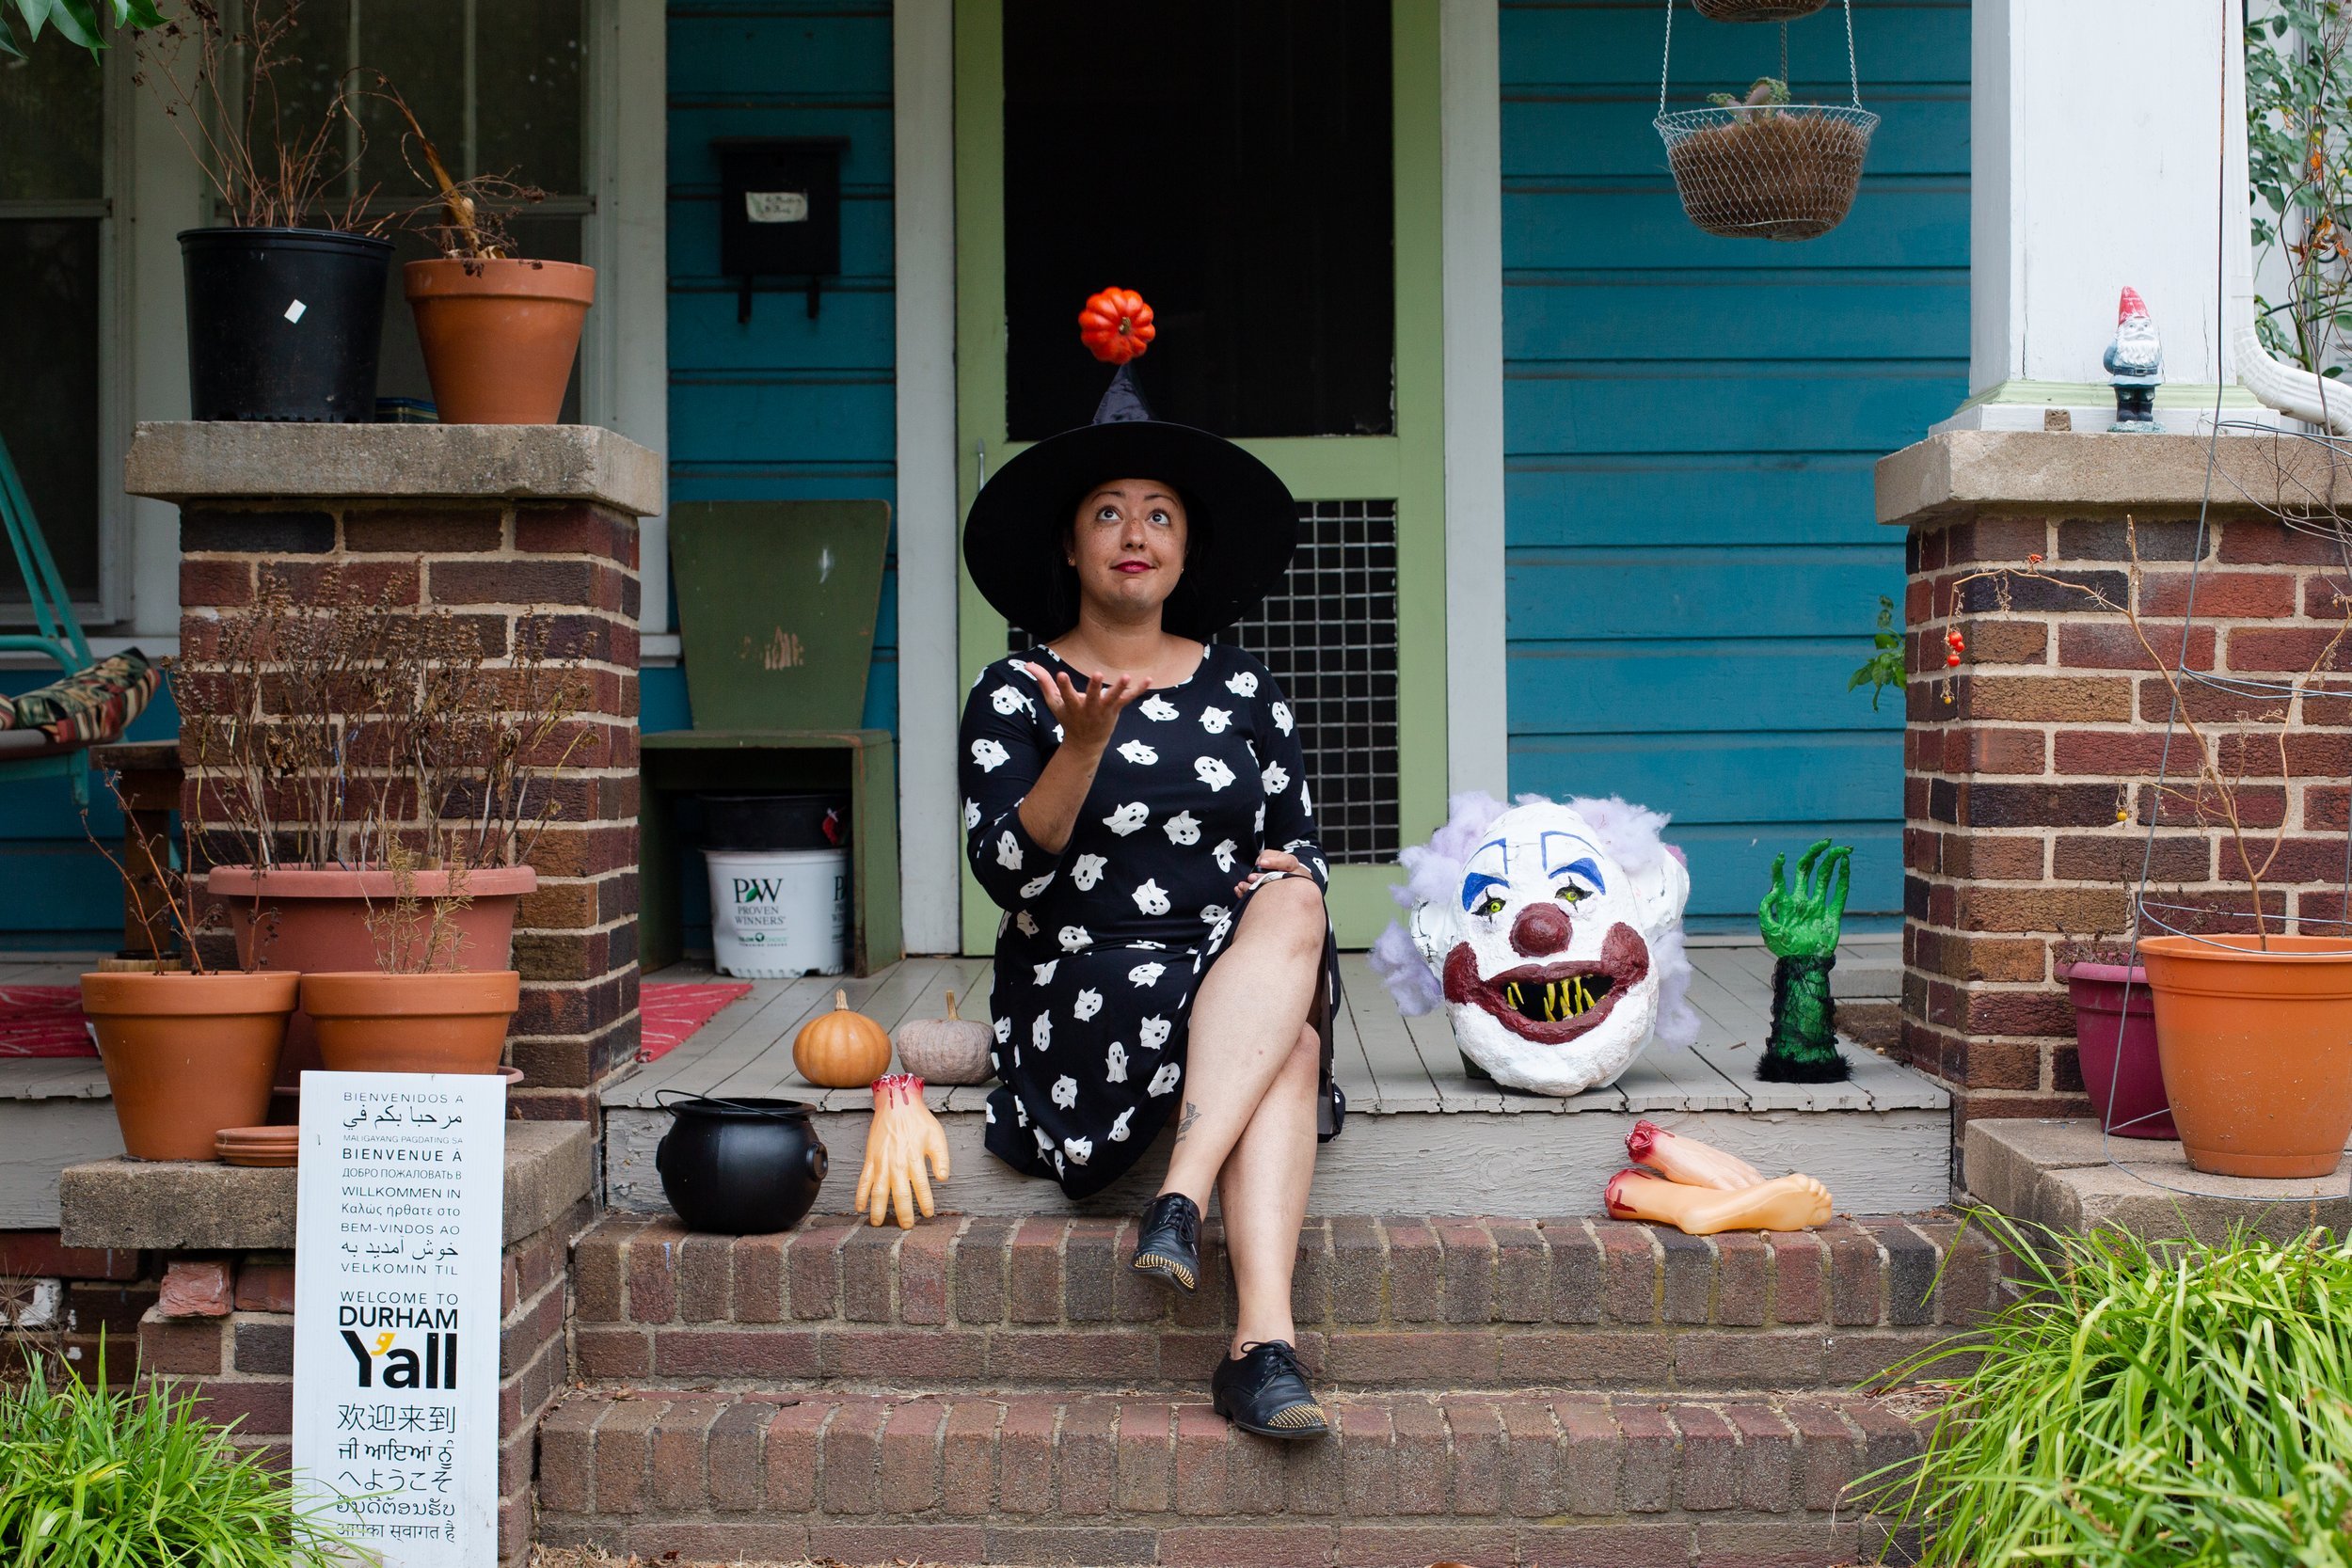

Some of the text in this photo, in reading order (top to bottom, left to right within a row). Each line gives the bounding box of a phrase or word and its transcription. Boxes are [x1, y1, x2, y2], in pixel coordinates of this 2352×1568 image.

[732, 878, 783, 903] PW
[738, 906, 779, 915] PROVEN
[735, 916, 784, 926] WINNERS
[344, 1092, 464, 1103] BIENVENIDOS A
[343, 1104, 462, 1131] مرحبا بكم في
[343, 1134, 398, 1143] MALIGAYANG
[342, 1148, 443, 1163] BIENVENUE
[342, 1168, 378, 1179] ДОБРО
[381, 1167, 453, 1180] ПОЖАЛОВАТЬ
[342, 1186, 460, 1198] WILLKOMMEN IN
[437, 1208, 460, 1216] στο
[342, 1223, 459, 1235] BEM-VINDOS AO
[341, 1262, 458, 1275] VELKOMIN TIL
[341, 1291, 458, 1307] WELCOME TO
[339, 1306, 458, 1329] DURHAM
[337, 1402, 455, 1433] 欢迎来到
[338, 1437, 359, 1460] ਜੀ
[339, 1469, 452, 1493] へようこそ
[444, 1520, 456, 1544] है
